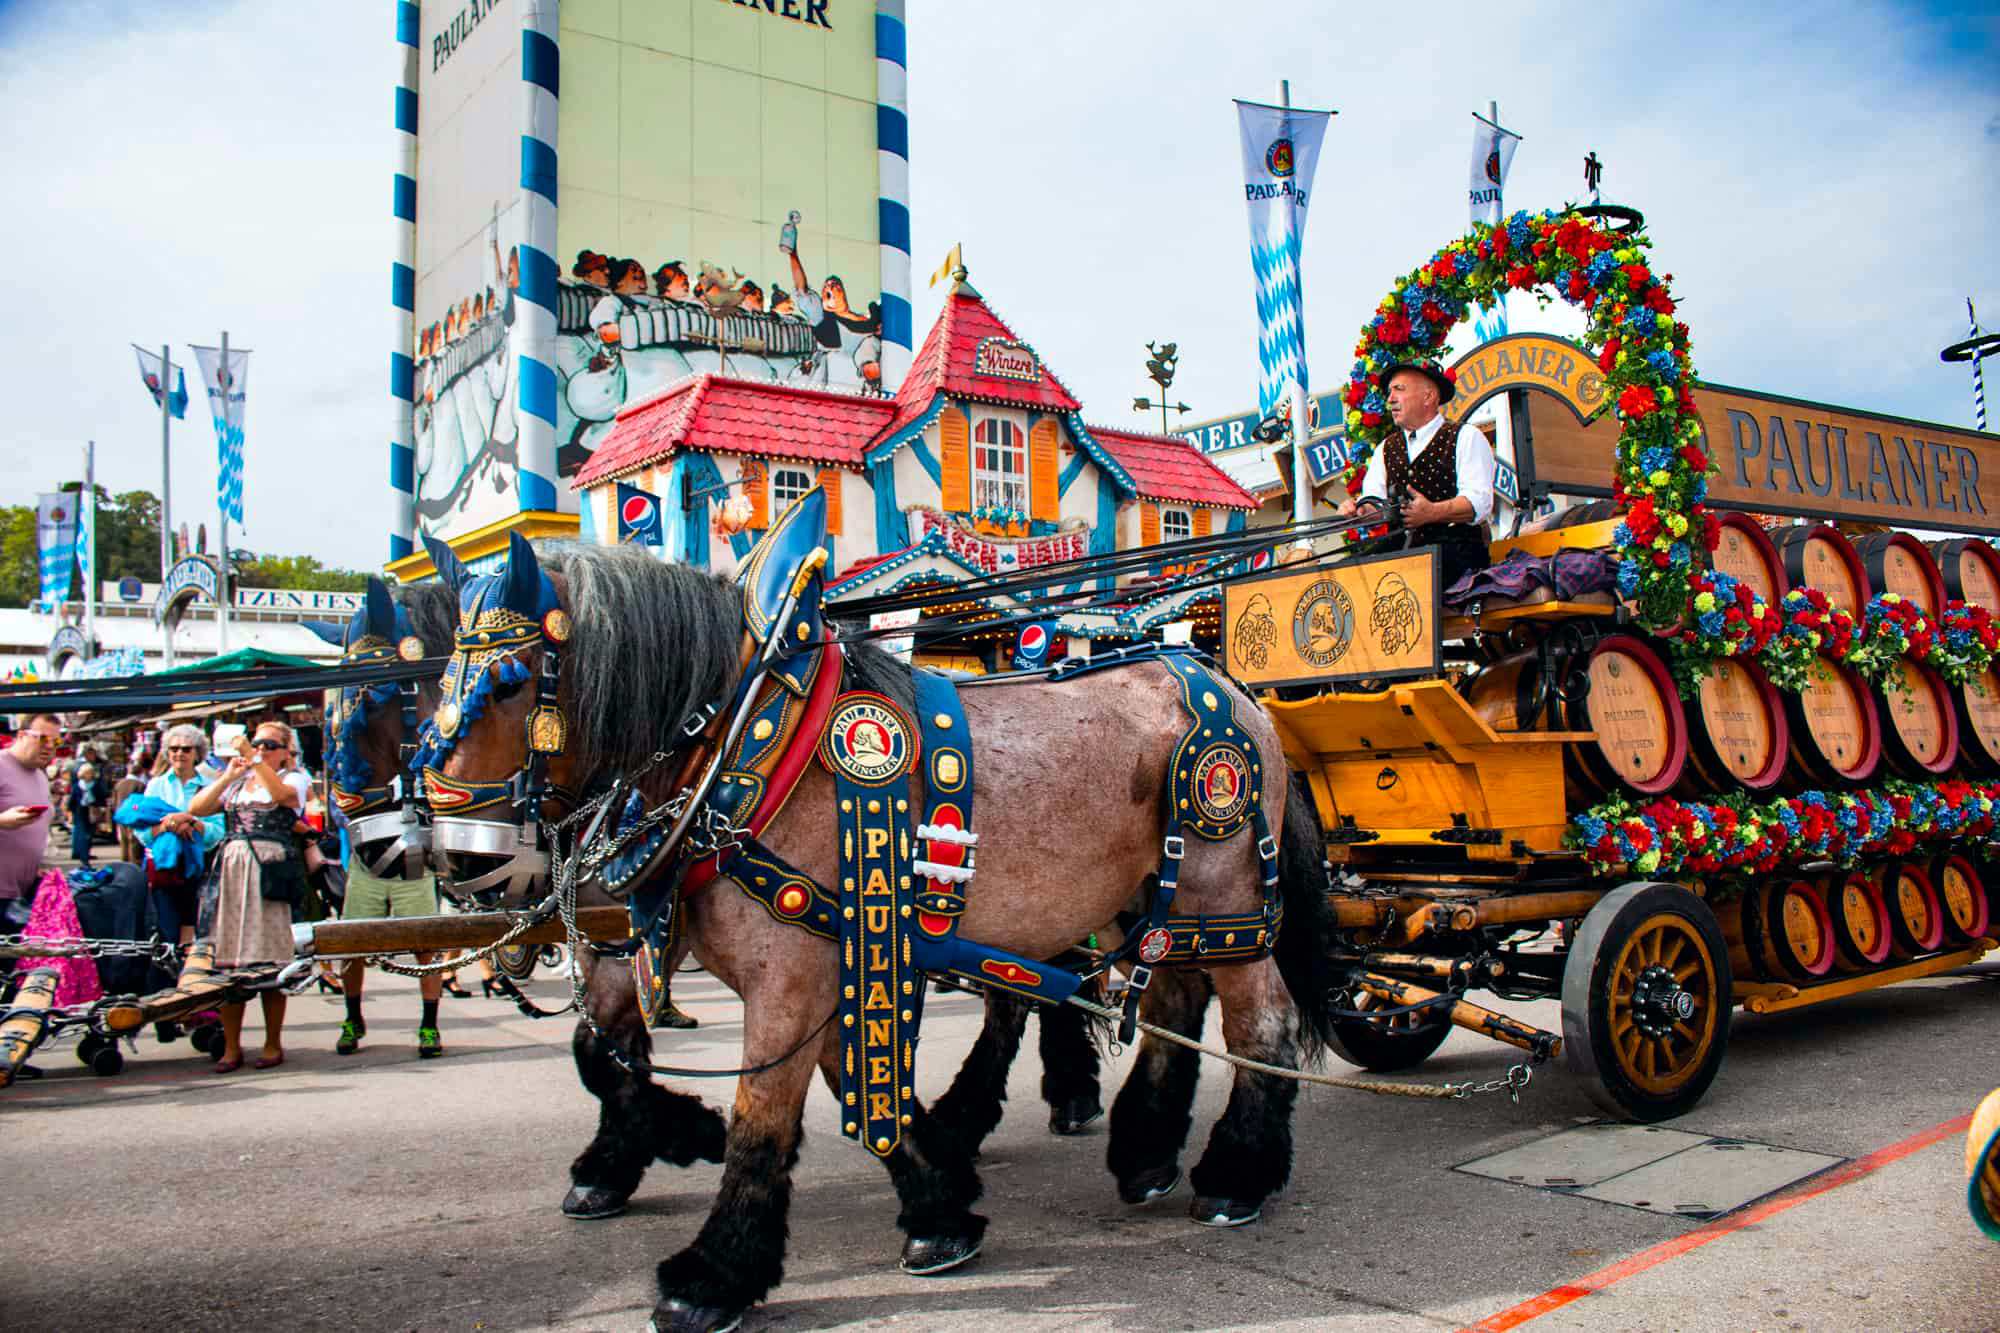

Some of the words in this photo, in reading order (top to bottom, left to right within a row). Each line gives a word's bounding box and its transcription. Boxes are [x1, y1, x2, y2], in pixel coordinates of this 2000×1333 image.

[1727, 408, 1987, 515] PAULANER
[1296, 583, 1351, 620] PAULANER
[834, 708, 899, 736] PAULANER
[1198, 751, 1246, 781] PAULANER
[863, 828, 893, 1121] PAULANER
